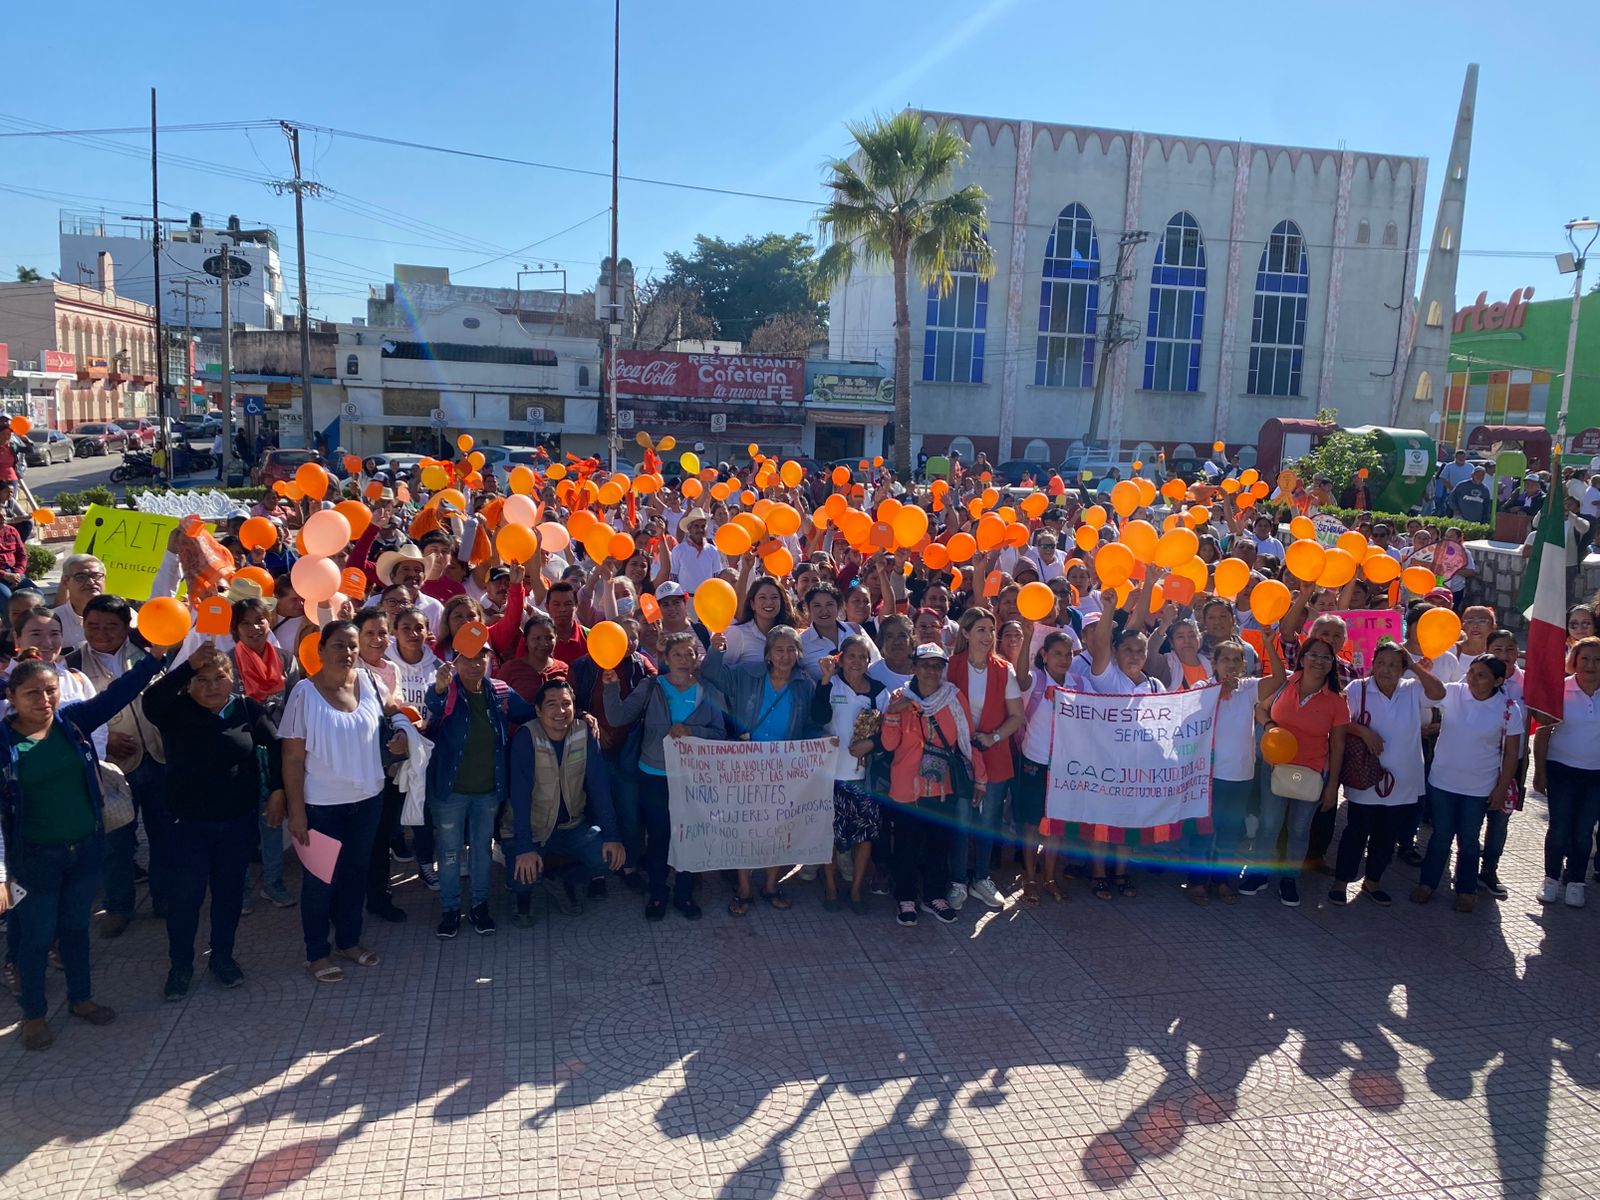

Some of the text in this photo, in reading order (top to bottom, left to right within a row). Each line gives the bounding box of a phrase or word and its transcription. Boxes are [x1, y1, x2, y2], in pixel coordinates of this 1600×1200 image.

[203, 247, 247, 257] HOEL
[1452, 286, 1535, 334] rteli
[698, 364, 788, 384] Cafetería
[713, 383, 793, 399] la nueva FE
[1059, 702, 1172, 722] BIENESTAR
[1114, 716, 1213, 743] SEMBRANDO
[697, 742, 764, 756] INTERNACIONAL
[769, 742, 780, 754] DE
[784, 741, 796, 754] LA
[716, 759, 726, 771] DE
[731, 759, 741, 772] LA
[743, 758, 784, 772] VIOLENCIA
[791, 754, 825, 770] CONTRA
[693, 772, 712, 784] LAS
[719, 770, 755, 784] MUJERES
[760, 771, 765, 782] Y
[769, 770, 784, 782] LAS
[685, 785, 719, 804] NIÑAS
[709, 808, 769, 823] MUJERES
[748, 828, 763, 840] EL
[804, 813, 817, 825] DE
